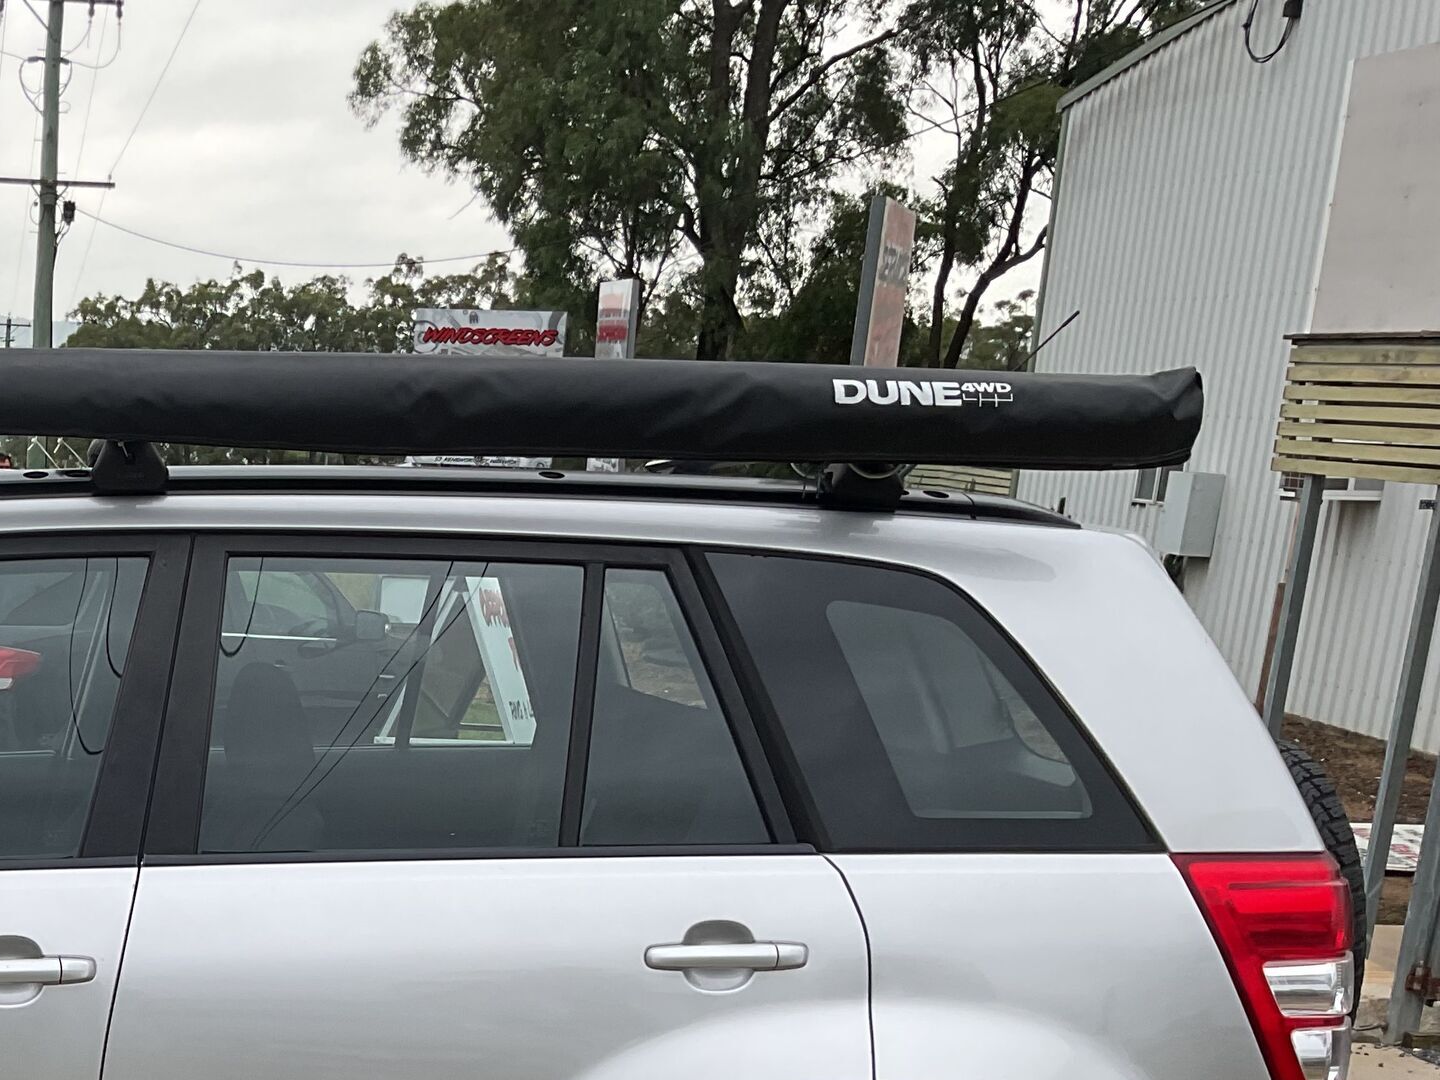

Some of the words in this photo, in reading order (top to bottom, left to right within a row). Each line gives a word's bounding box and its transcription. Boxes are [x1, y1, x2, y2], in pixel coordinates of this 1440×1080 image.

[423, 326, 559, 346] WINDSCREENS
[832, 379, 962, 407] DUNE
[961, 382, 1012, 393] 4WD
